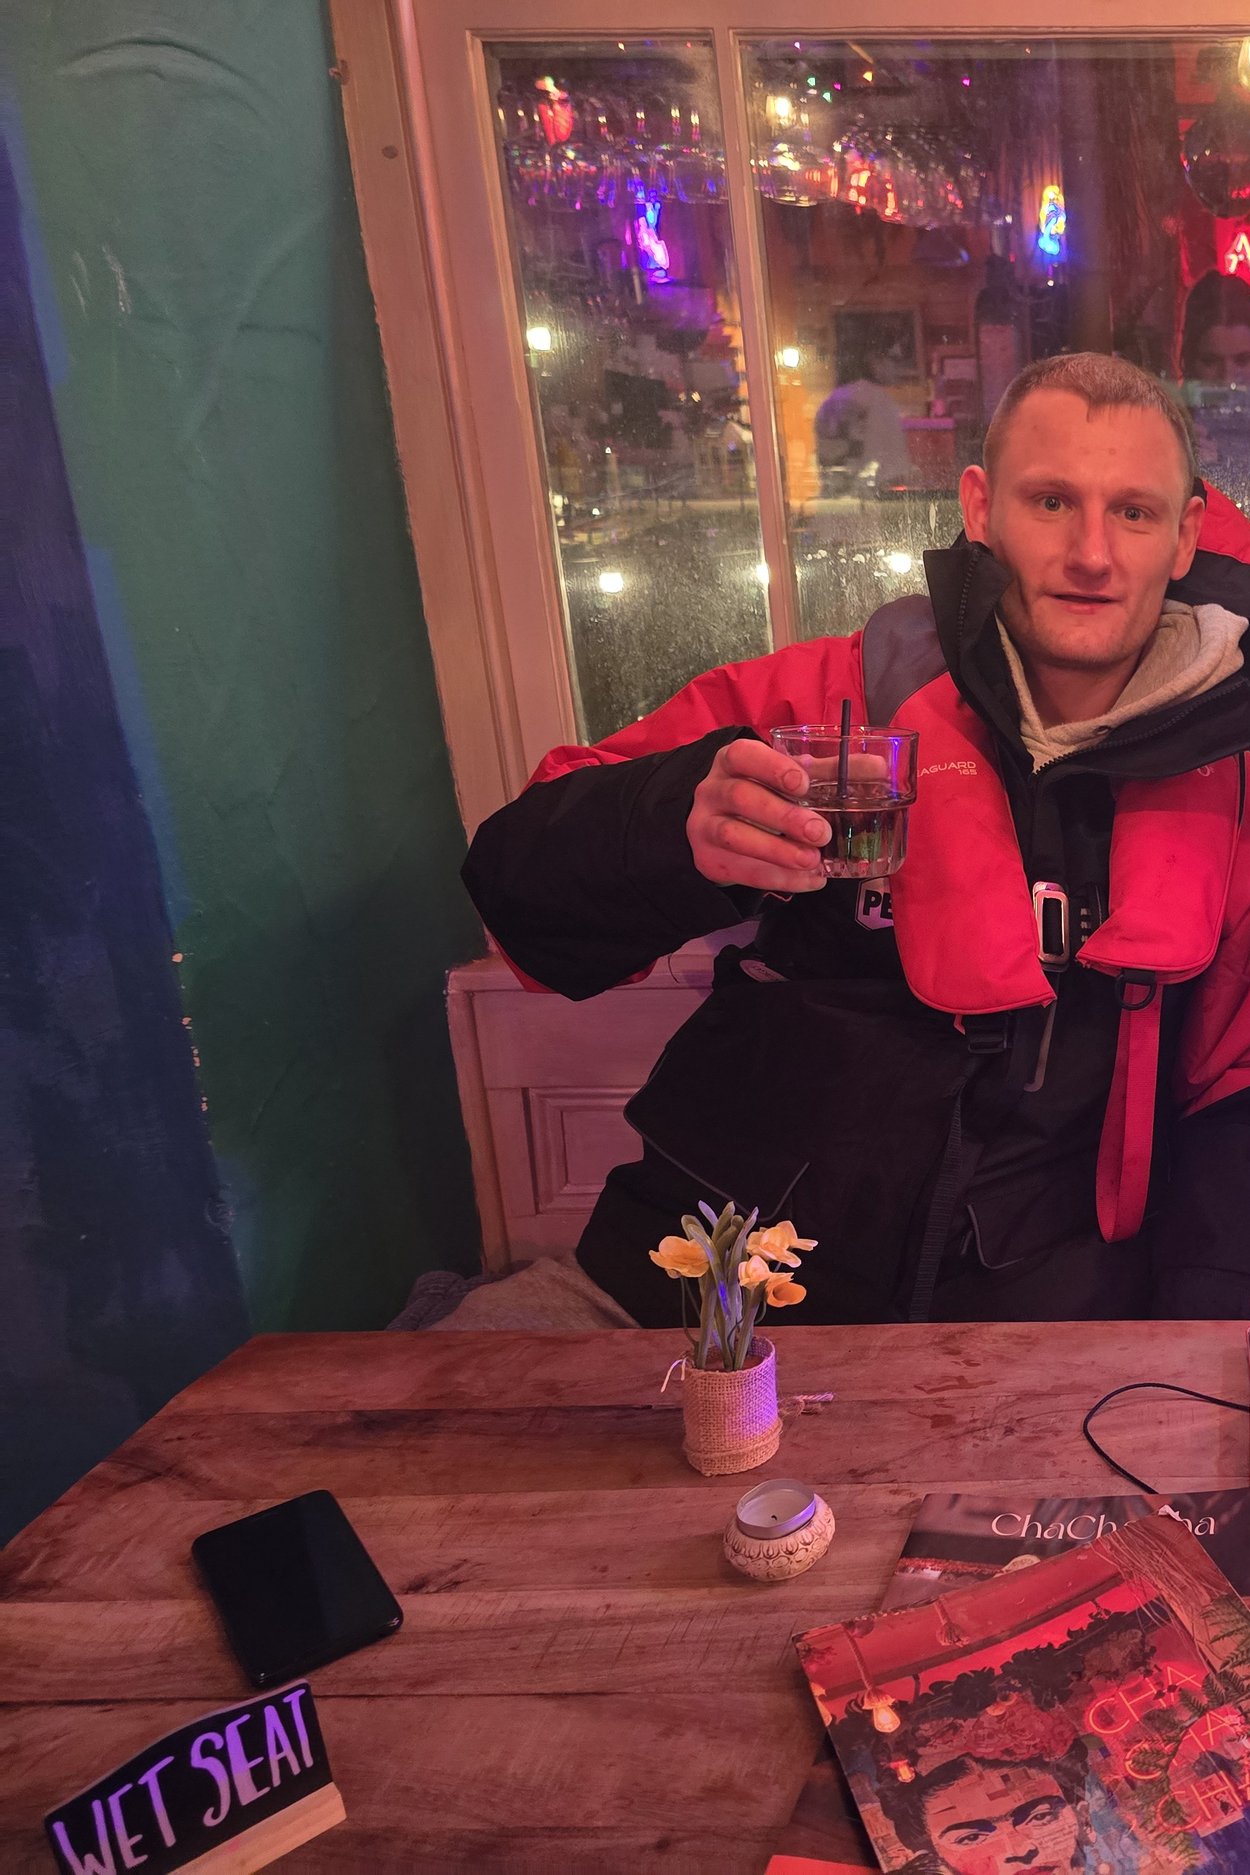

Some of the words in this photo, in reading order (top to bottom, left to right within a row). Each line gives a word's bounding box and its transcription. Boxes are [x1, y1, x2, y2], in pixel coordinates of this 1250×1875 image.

[1089, 1666, 1202, 1734] CHA
[52, 1755, 177, 1875] WET
[190, 1688, 314, 1828] SEAT
